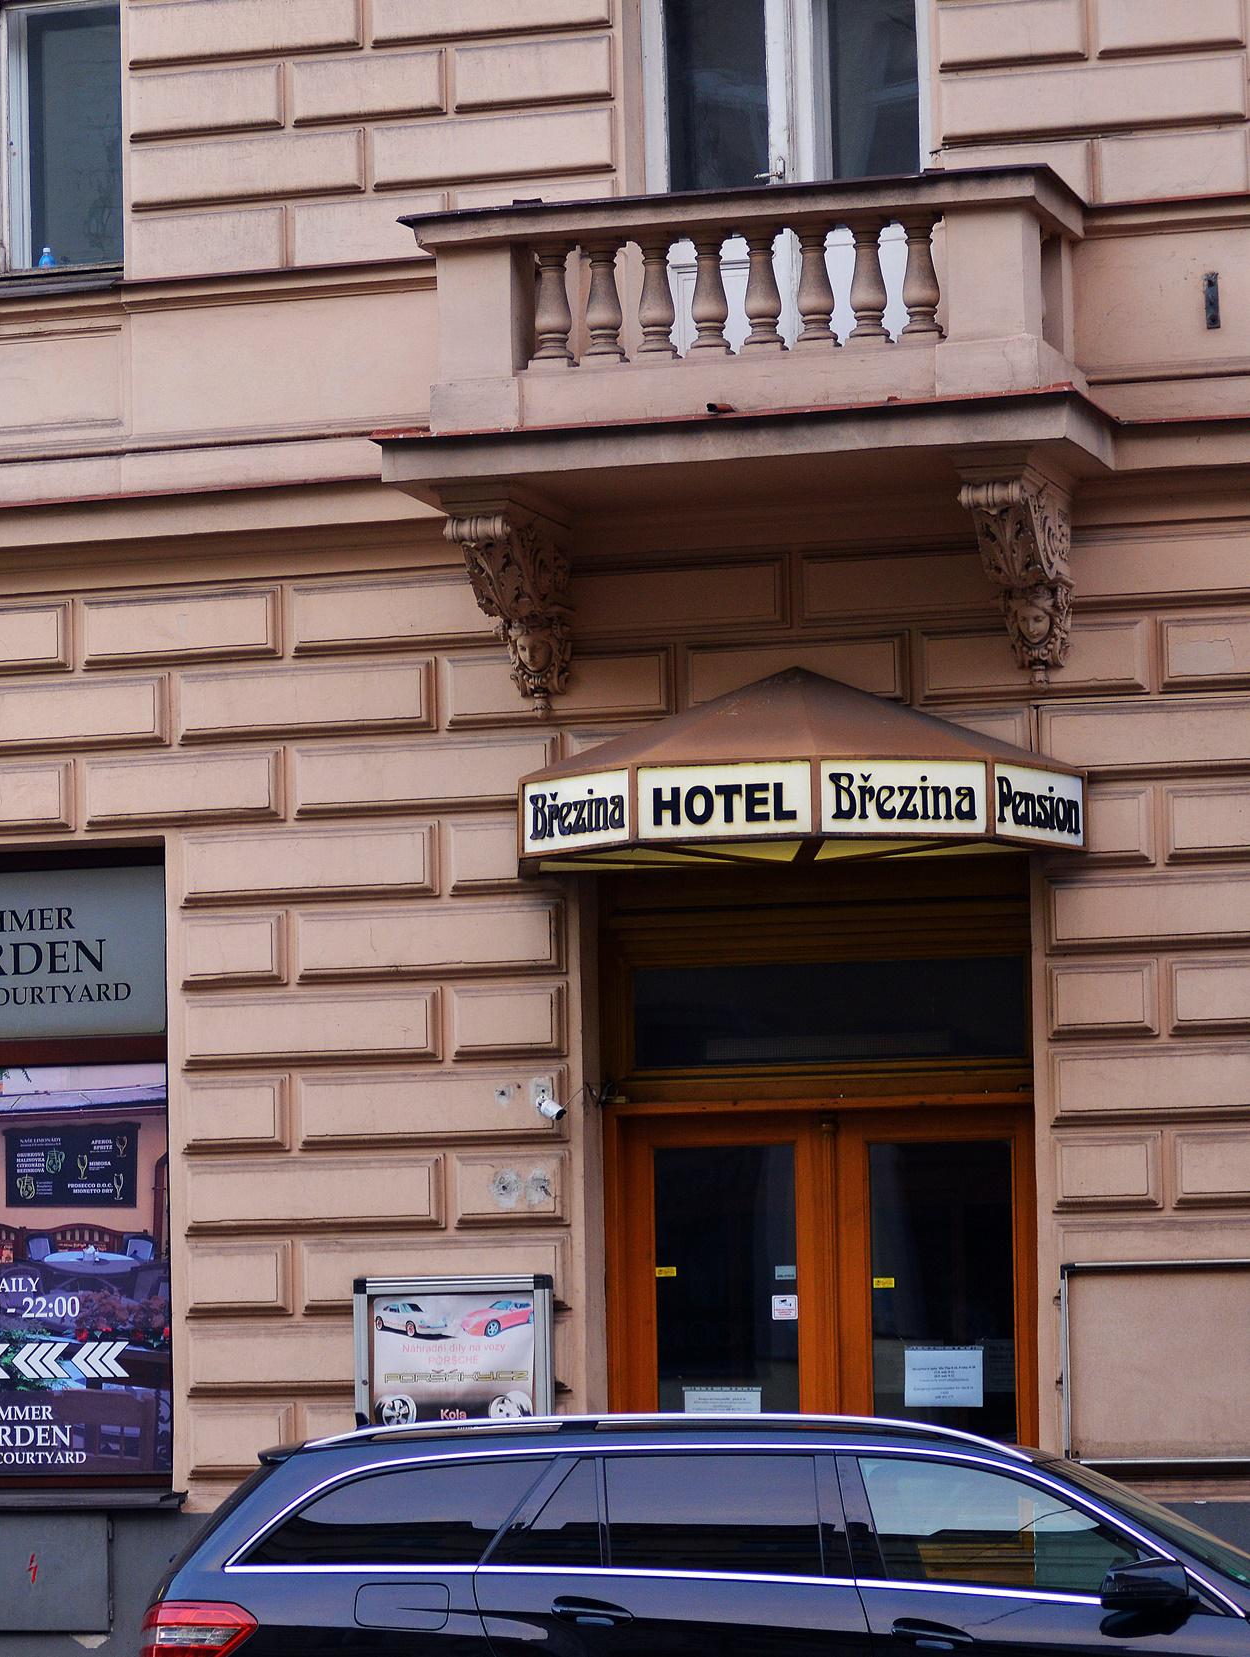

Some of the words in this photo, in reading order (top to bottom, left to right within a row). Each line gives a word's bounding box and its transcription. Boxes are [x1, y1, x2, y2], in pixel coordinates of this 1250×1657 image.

[529, 788, 626, 841] Březina
[652, 782, 798, 827] HOTEL
[828, 771, 978, 822] Březina
[996, 775, 1082, 835] Pension
[21, 1296, 80, 1319] 22:00
[428, 1356, 479, 1365] PORSCHE
[440, 1408, 467, 1420] Kola
